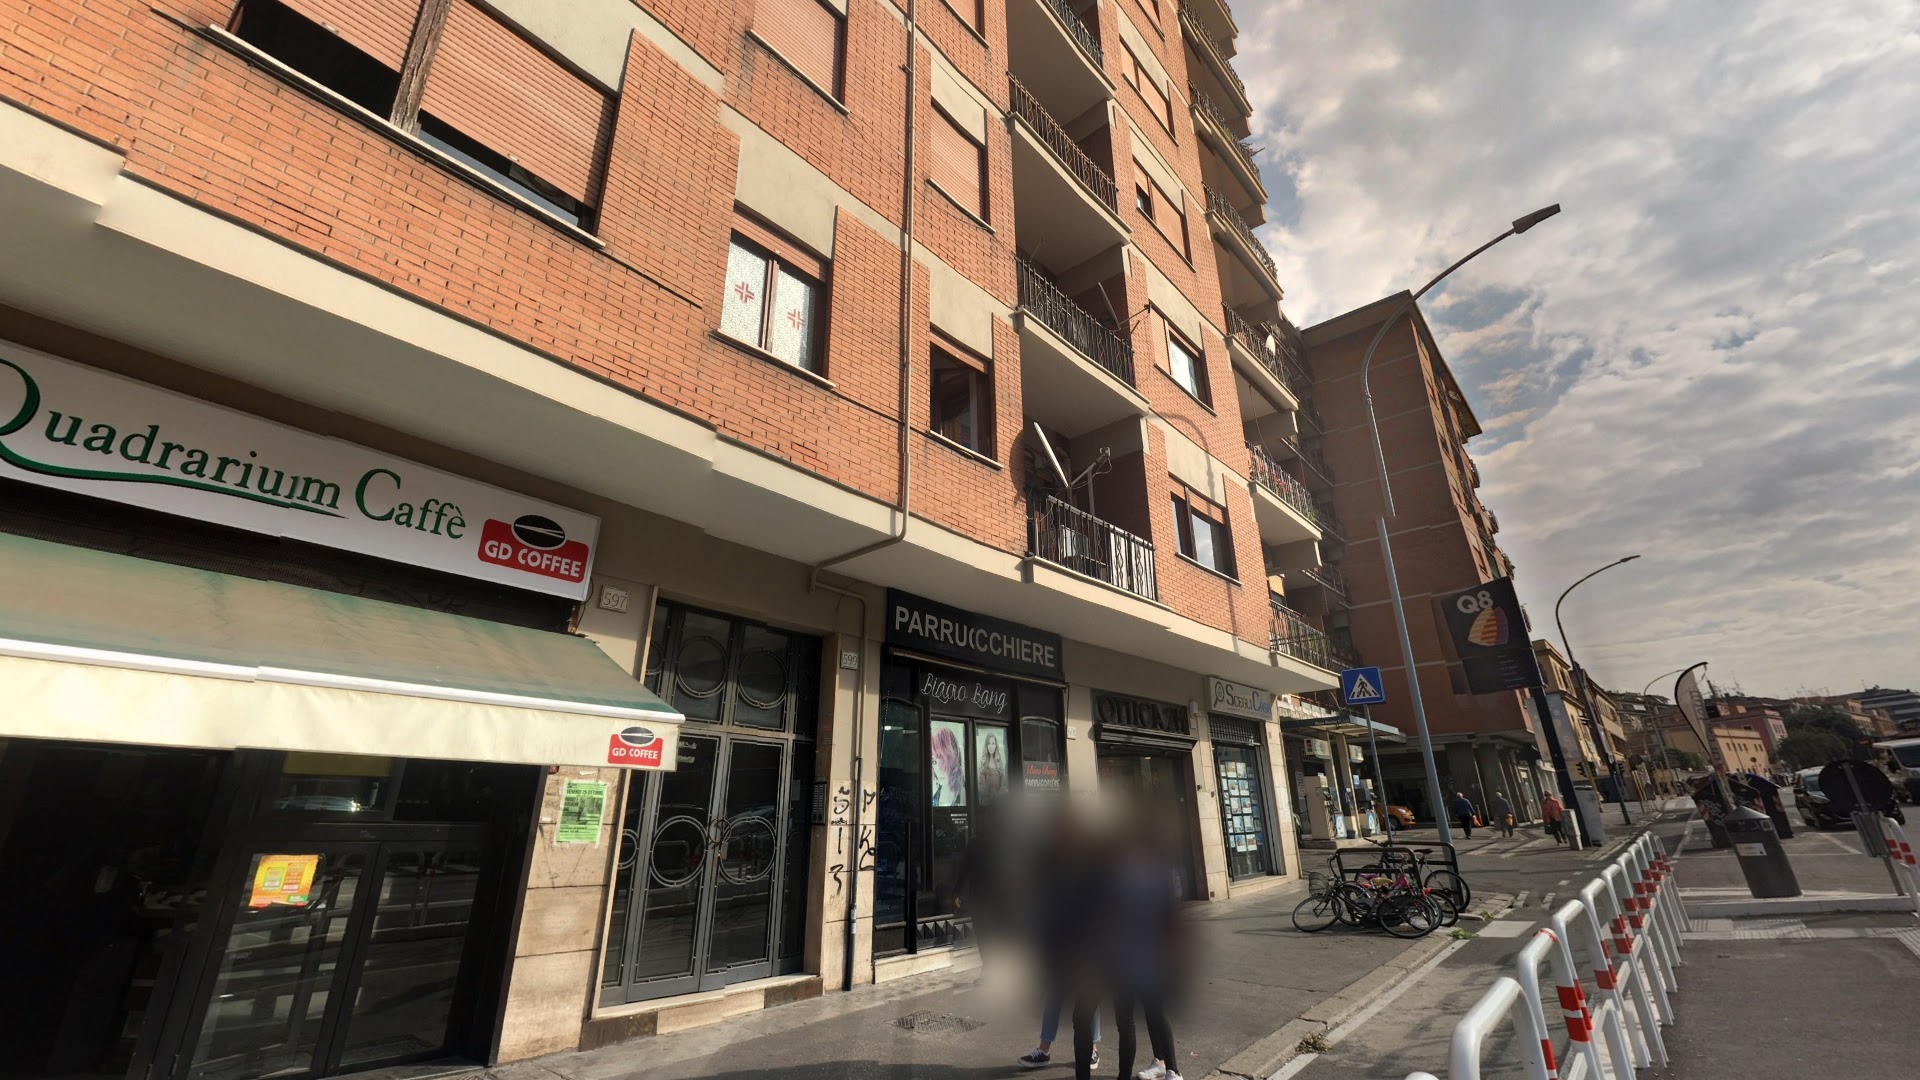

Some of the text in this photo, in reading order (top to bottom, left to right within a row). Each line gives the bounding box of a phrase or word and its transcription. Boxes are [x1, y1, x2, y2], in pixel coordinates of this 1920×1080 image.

[355, 468, 466, 539] Caffè
[484, 540, 582, 578] GD COFFEE
[603, 593, 627, 608] 597
[1456, 590, 1494, 614] Q8
[842, 654, 858, 666] 599
[970, 682, 1008, 714] Bang
[612, 747, 658, 759] GD COFFEE
